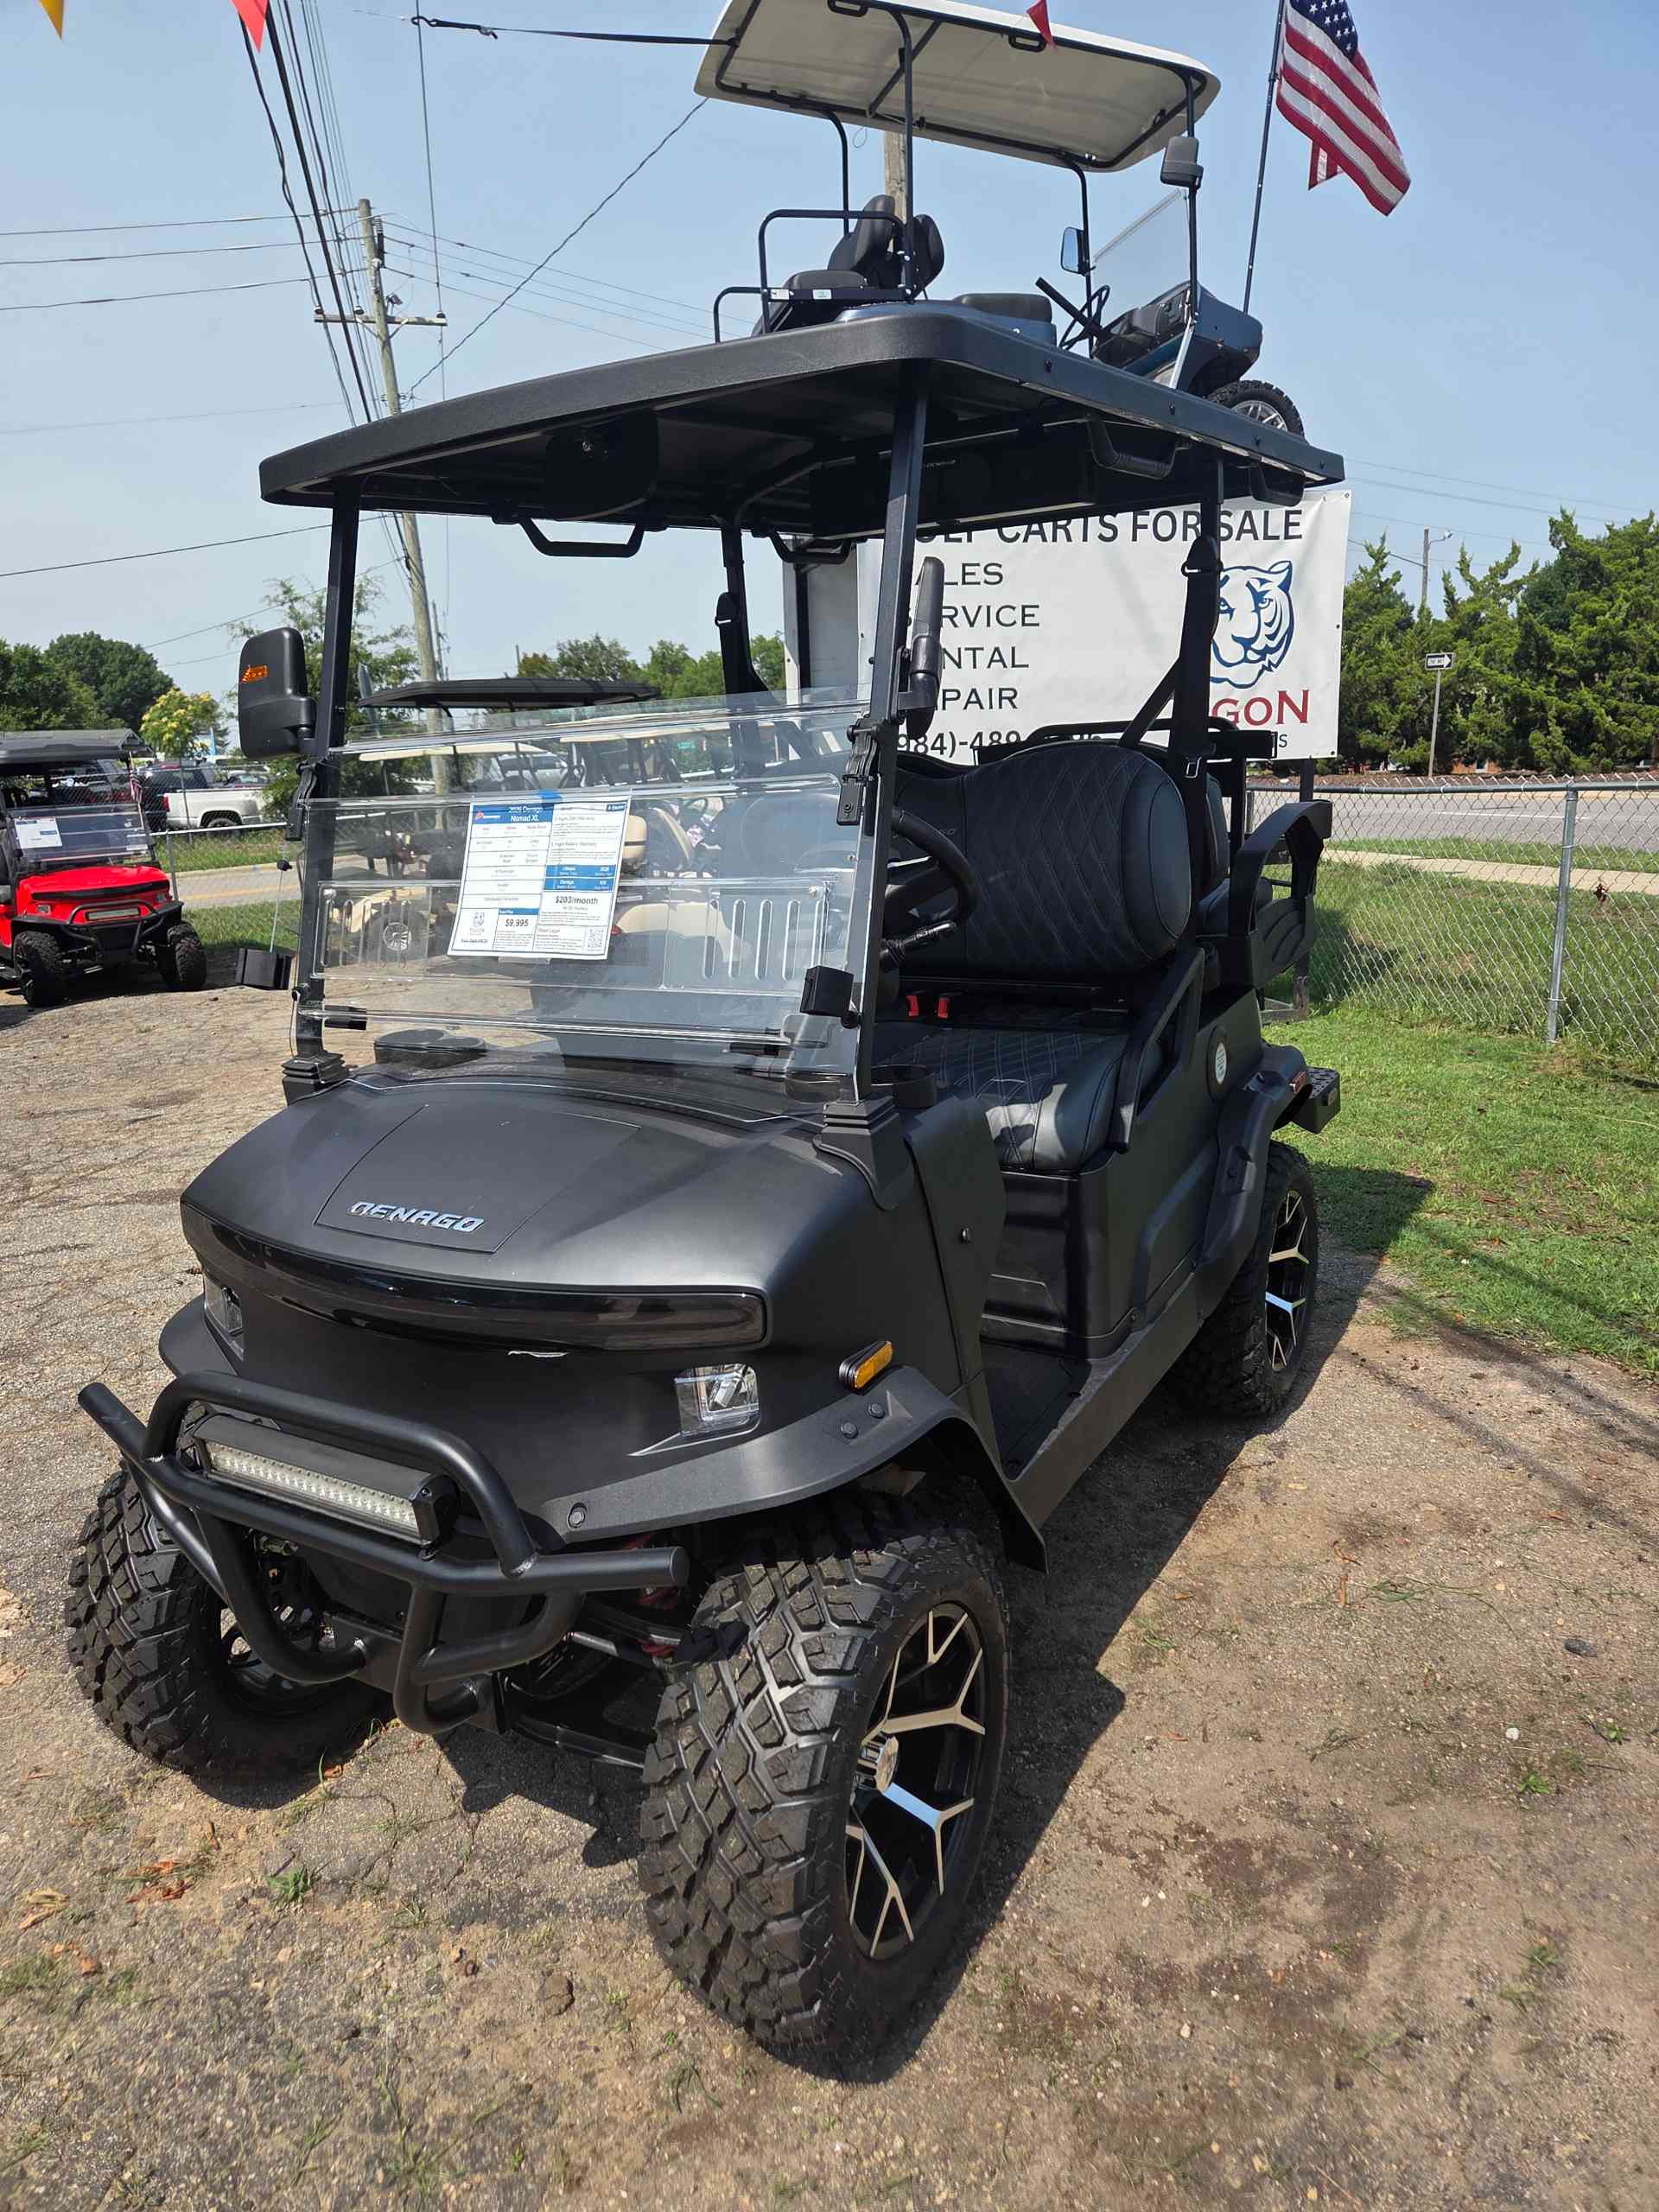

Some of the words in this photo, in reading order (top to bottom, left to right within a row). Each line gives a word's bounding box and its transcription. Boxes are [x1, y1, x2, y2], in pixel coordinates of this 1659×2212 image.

[1131, 510, 1202, 542] FOR
[1219, 510, 1303, 541] SALE
[907, 604, 1040, 628] RVICE
[942, 646, 1030, 670] NTAL
[936, 687, 1019, 710] PAIR
[1211, 690, 1310, 727] GON
[350, 1201, 486, 1233] DENAGO
